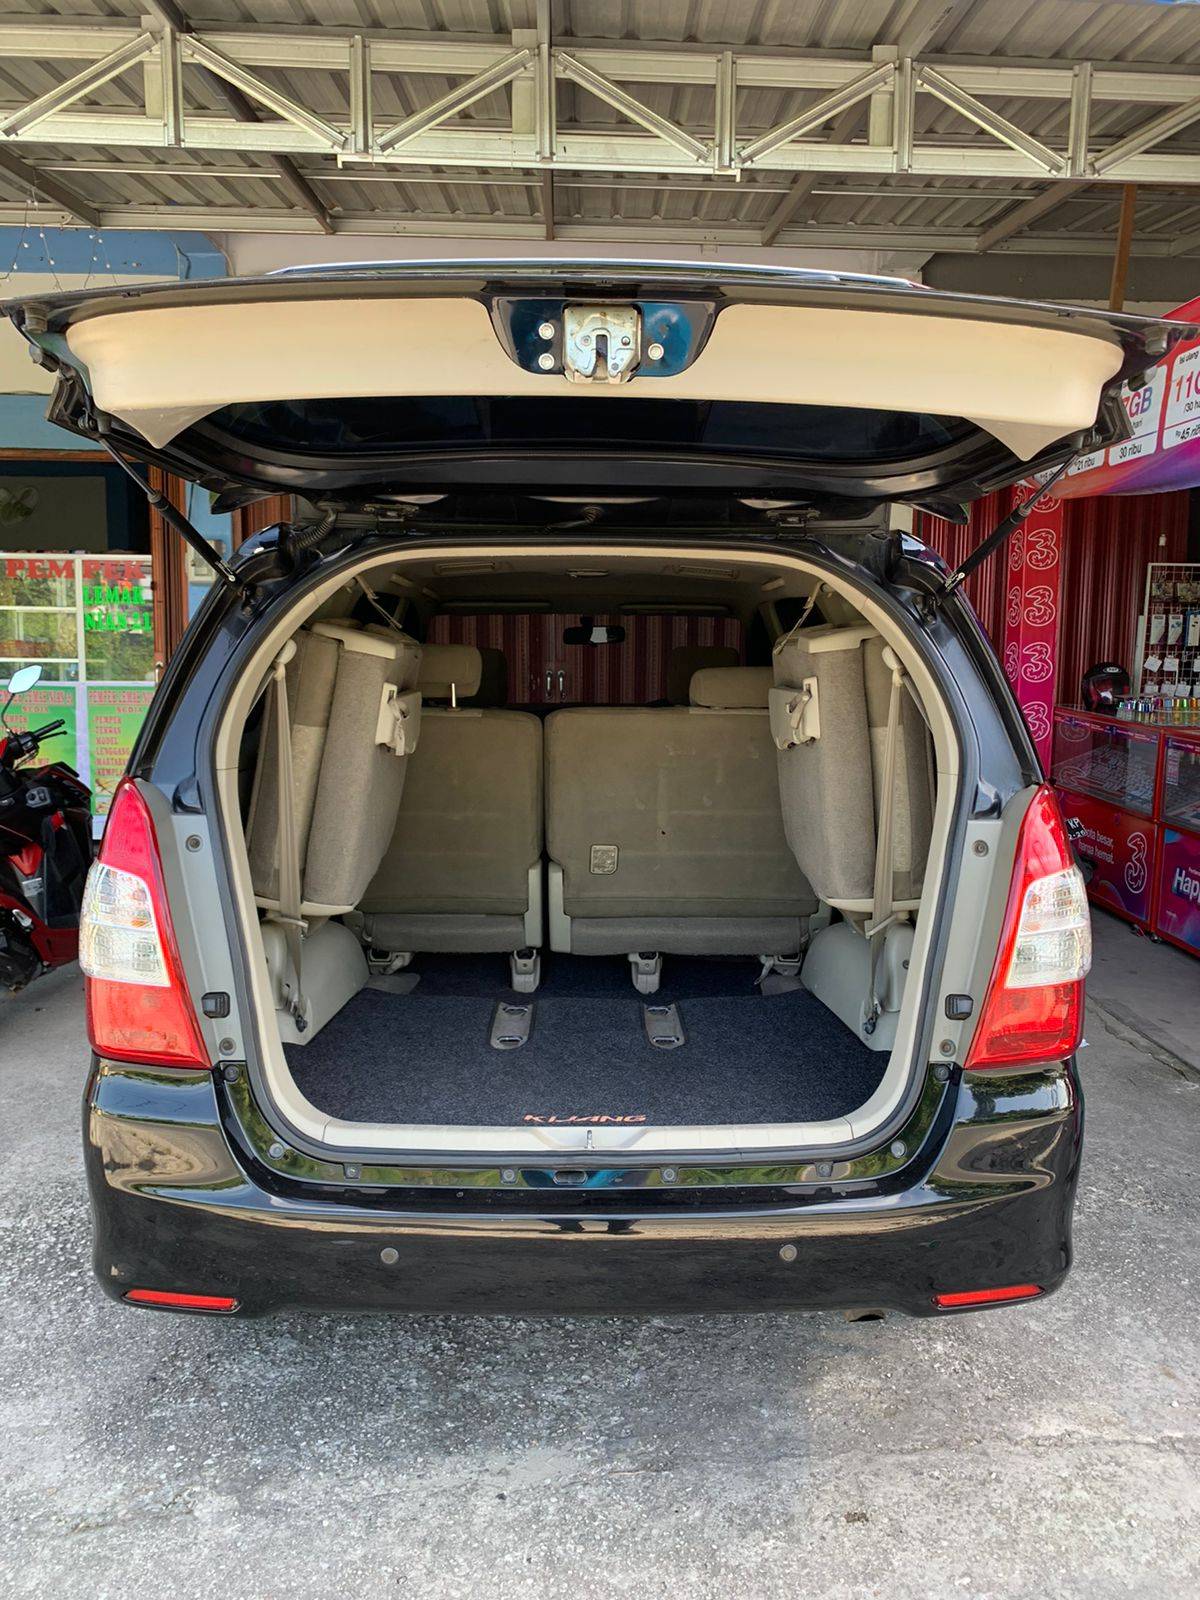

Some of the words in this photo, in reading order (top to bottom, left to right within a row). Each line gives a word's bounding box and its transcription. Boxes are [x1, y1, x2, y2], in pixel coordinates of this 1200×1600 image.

[1180, 427, 1190, 440] 45
[1119, 447, 1128, 459] 30
[1128, 443, 1142, 456] ribu
[83, 585, 145, 605] LEMAK
[522, 1113, 647, 1125] KIJANG
